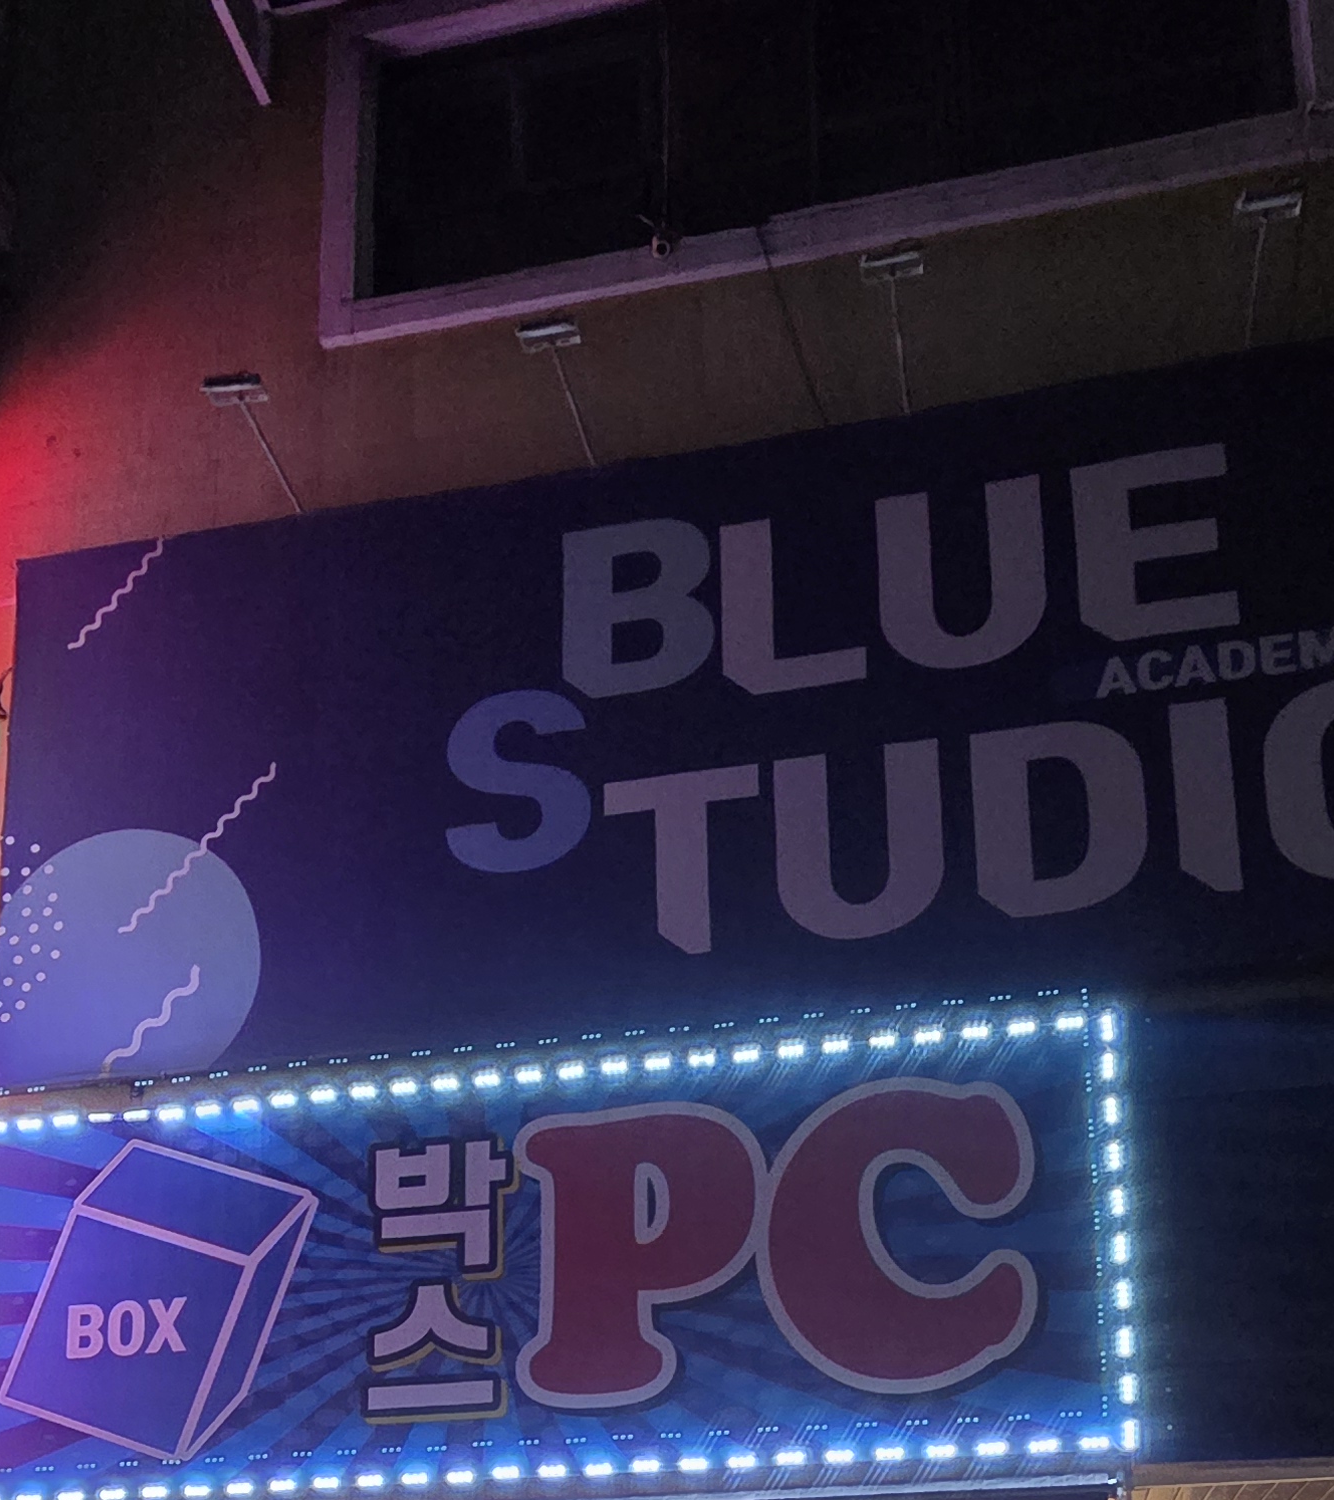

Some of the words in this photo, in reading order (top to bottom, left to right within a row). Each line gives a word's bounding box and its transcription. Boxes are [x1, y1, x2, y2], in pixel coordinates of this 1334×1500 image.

[561, 442, 1241, 700] BLUE
[67, 1297, 187, 1358] BOX
[365, 1138, 507, 1418] 박스
[515, 1076, 1037, 1409] PC
